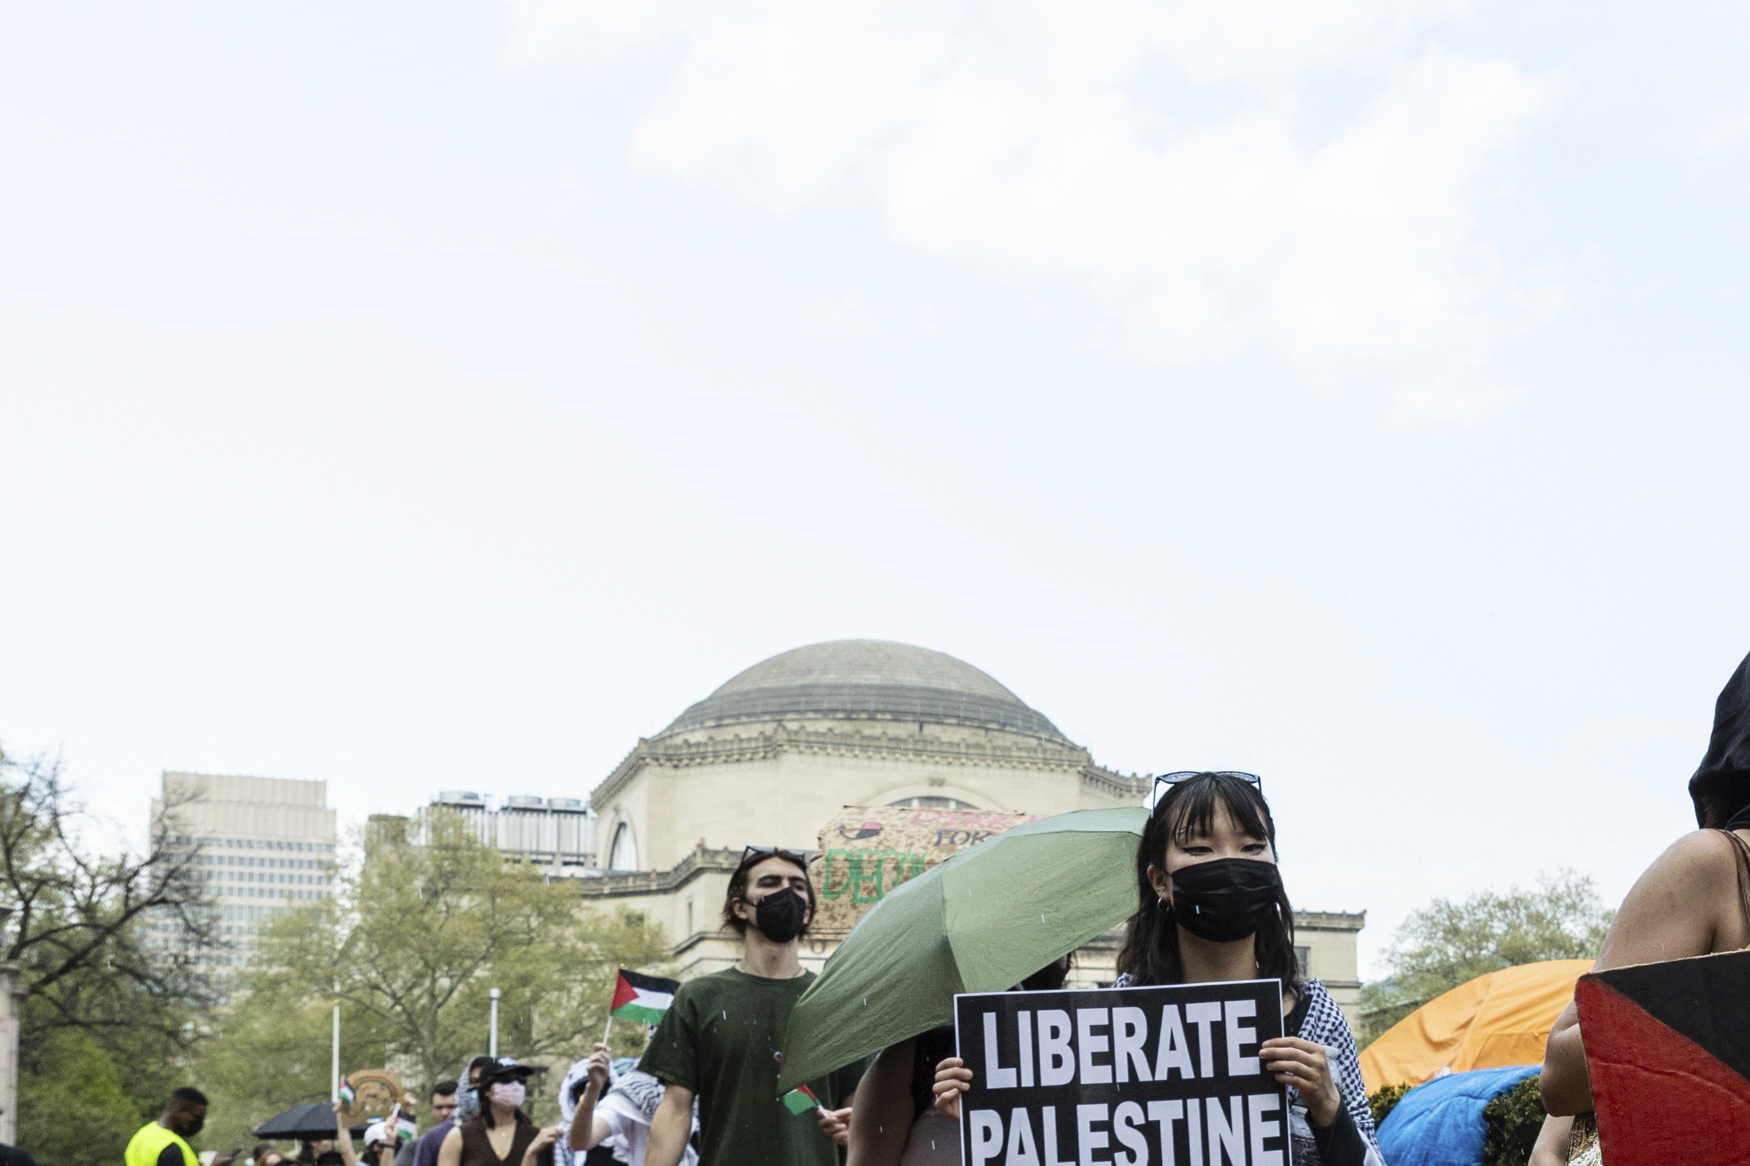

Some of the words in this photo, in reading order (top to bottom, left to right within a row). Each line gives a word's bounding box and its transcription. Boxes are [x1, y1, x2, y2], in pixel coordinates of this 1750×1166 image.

[910, 809, 1040, 830] DYKE
[934, 829, 994, 848] FOR
[982, 999, 1261, 1089] LIBERATE
